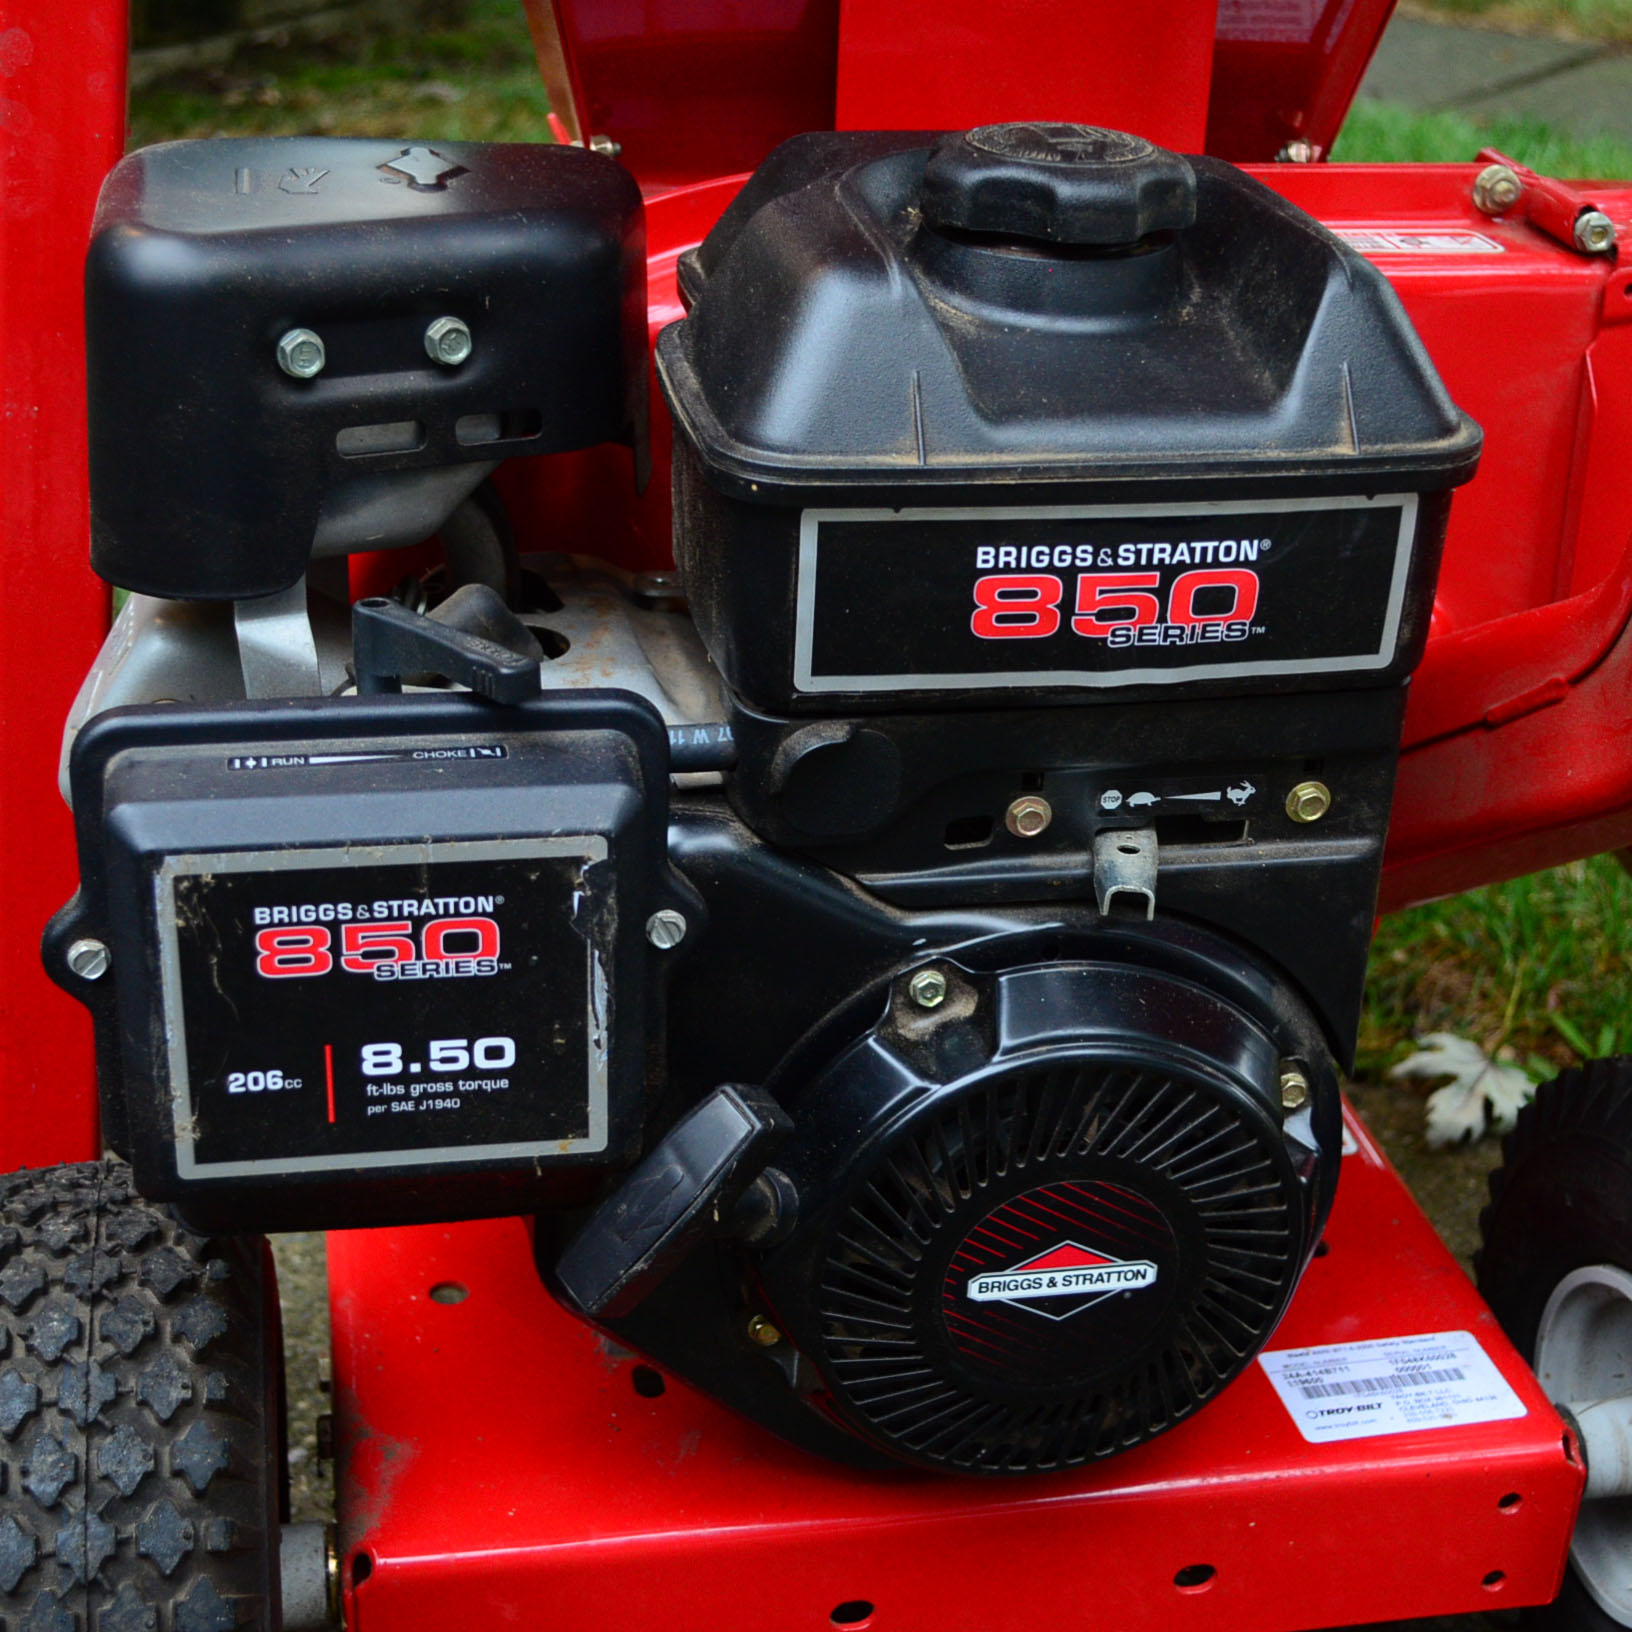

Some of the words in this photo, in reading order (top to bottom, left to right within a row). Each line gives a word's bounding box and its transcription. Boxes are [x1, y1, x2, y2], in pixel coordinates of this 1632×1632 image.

[971, 568, 1260, 639] 850
[1107, 620, 1251, 648] SERIES
[272, 757, 305, 767] RUN
[412, 749, 467, 760] CHOKE
[1102, 795, 1121, 804] STOP
[256, 917, 500, 979] 850
[373, 958, 499, 981] SERIES
[360, 1036, 517, 1077] 8.50
[366, 1083, 406, 1097] ft-lbs
[410, 1082, 454, 1098] gross
[458, 1078, 510, 1093] torque
[367, 1104, 388, 1117] per
[391, 1101, 416, 1113] SAE
[419, 1098, 462, 1111] J1940
[977, 1276, 1044, 1294] BRIGGS
[1046, 1275, 1059, 1289] &
[1061, 1268, 1148, 1288] STRATTON
